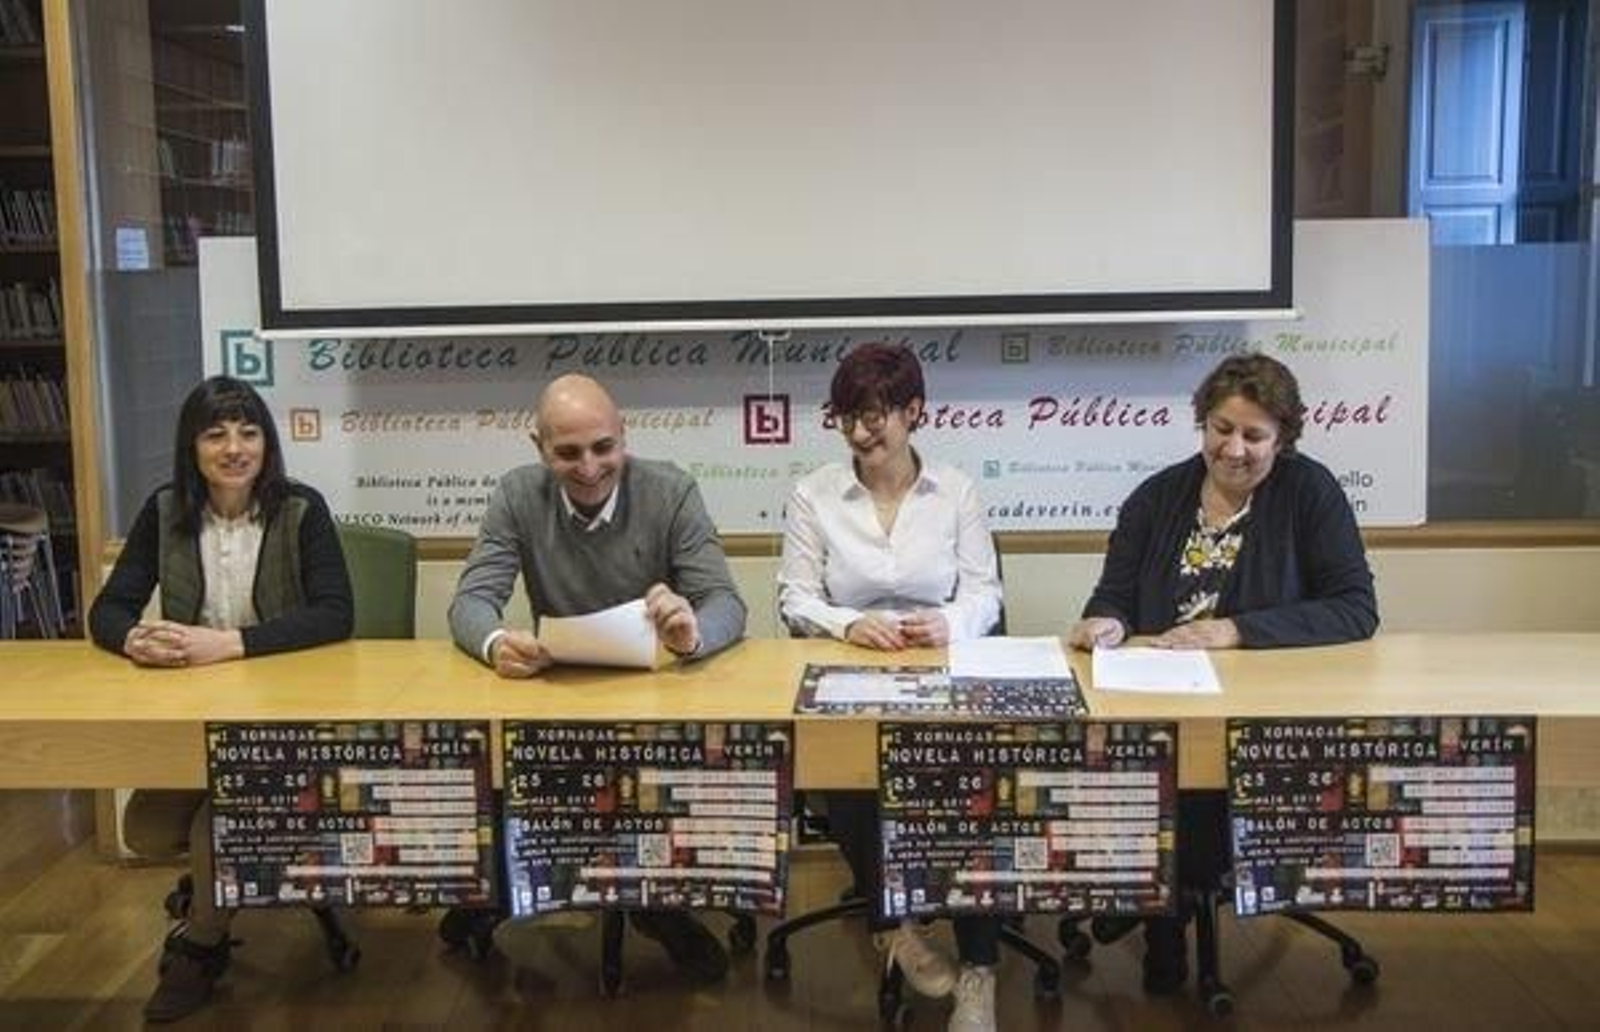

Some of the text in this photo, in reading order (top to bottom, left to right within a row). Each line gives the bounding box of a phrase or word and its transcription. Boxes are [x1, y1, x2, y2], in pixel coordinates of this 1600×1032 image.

[308, 337, 518, 371] Biblioteca
[544, 331, 709, 370] Pública
[340, 408, 462, 433] Biblioteca
[1028, 395, 1172, 430] Pública
[217, 742, 403, 761] NOVELA HISTÓRICA
[513, 742, 704, 761] NOVELA HISTÓRICA
[889, 742, 1084, 763] NOVELA HISTÓRICA
[1235, 740, 1438, 759] NOVELA HISTÓRICA
[226, 816, 277, 830] SALÓN
[286, 817, 307, 830] DE
[522, 815, 573, 832] SALÓN
[582, 817, 604, 830] DE
[896, 819, 948, 835] SALÓN
[957, 821, 981, 834] DE
[1245, 816, 1298, 832] SALÓN
[1307, 816, 1330, 831] DE
